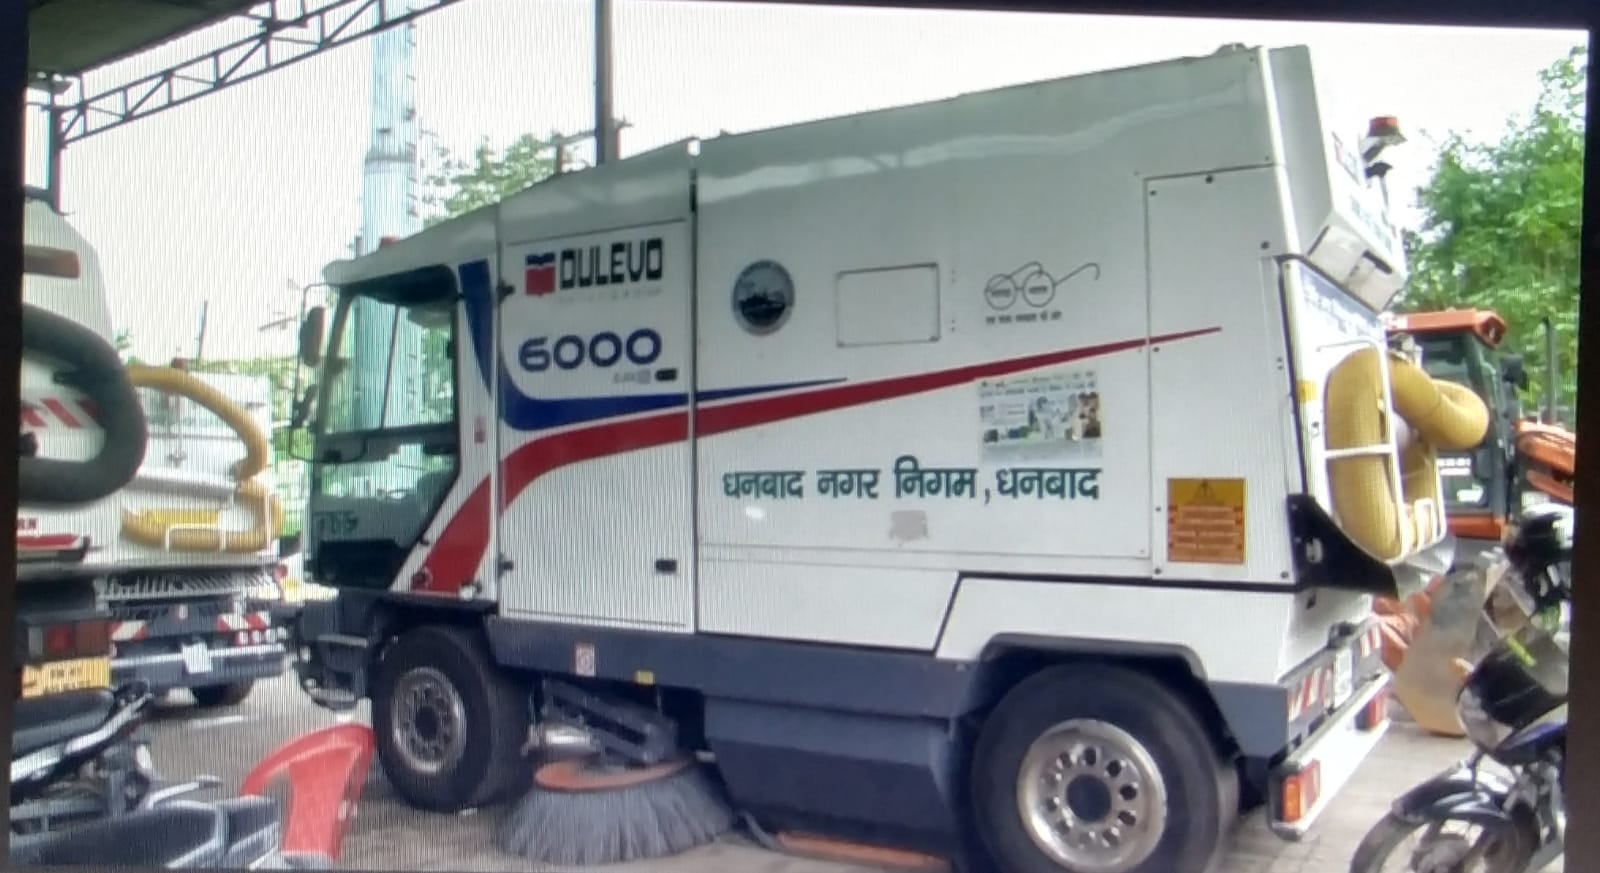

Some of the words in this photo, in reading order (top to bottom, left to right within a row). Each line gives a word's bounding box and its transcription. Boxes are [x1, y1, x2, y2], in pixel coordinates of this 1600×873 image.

[560, 238, 663, 290] DULEVO
[518, 328, 662, 372] 6000
[816, 468, 881, 499] नगर
